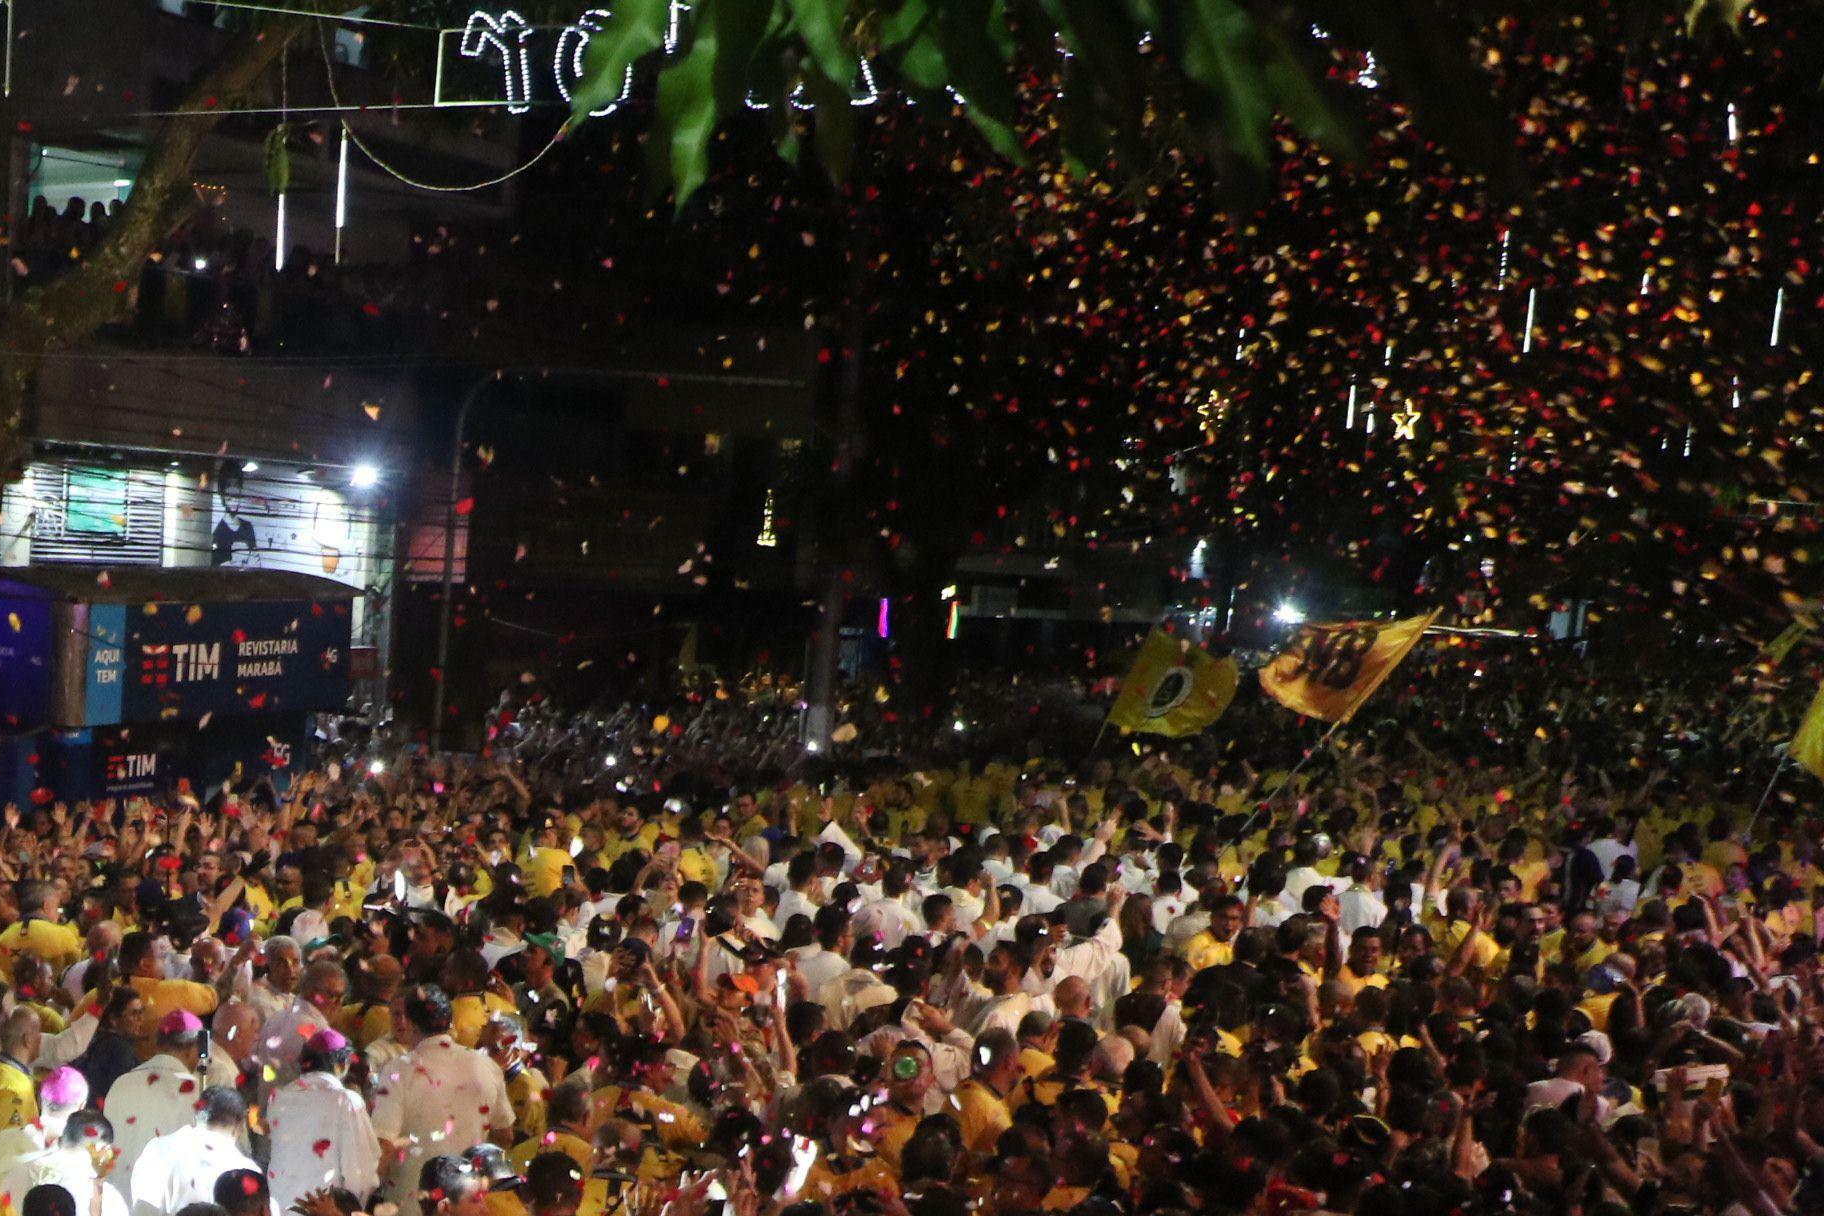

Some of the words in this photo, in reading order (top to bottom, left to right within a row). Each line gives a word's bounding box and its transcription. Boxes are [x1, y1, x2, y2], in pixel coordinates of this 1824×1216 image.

[94, 648, 121, 666] AQUI
[238, 639, 299, 657] REVISTARIA
[172, 642, 222, 683] TIM
[237, 657, 283, 678] MARABÁ
[95, 669, 118, 684] TEM
[126, 753, 157, 777] TIM
